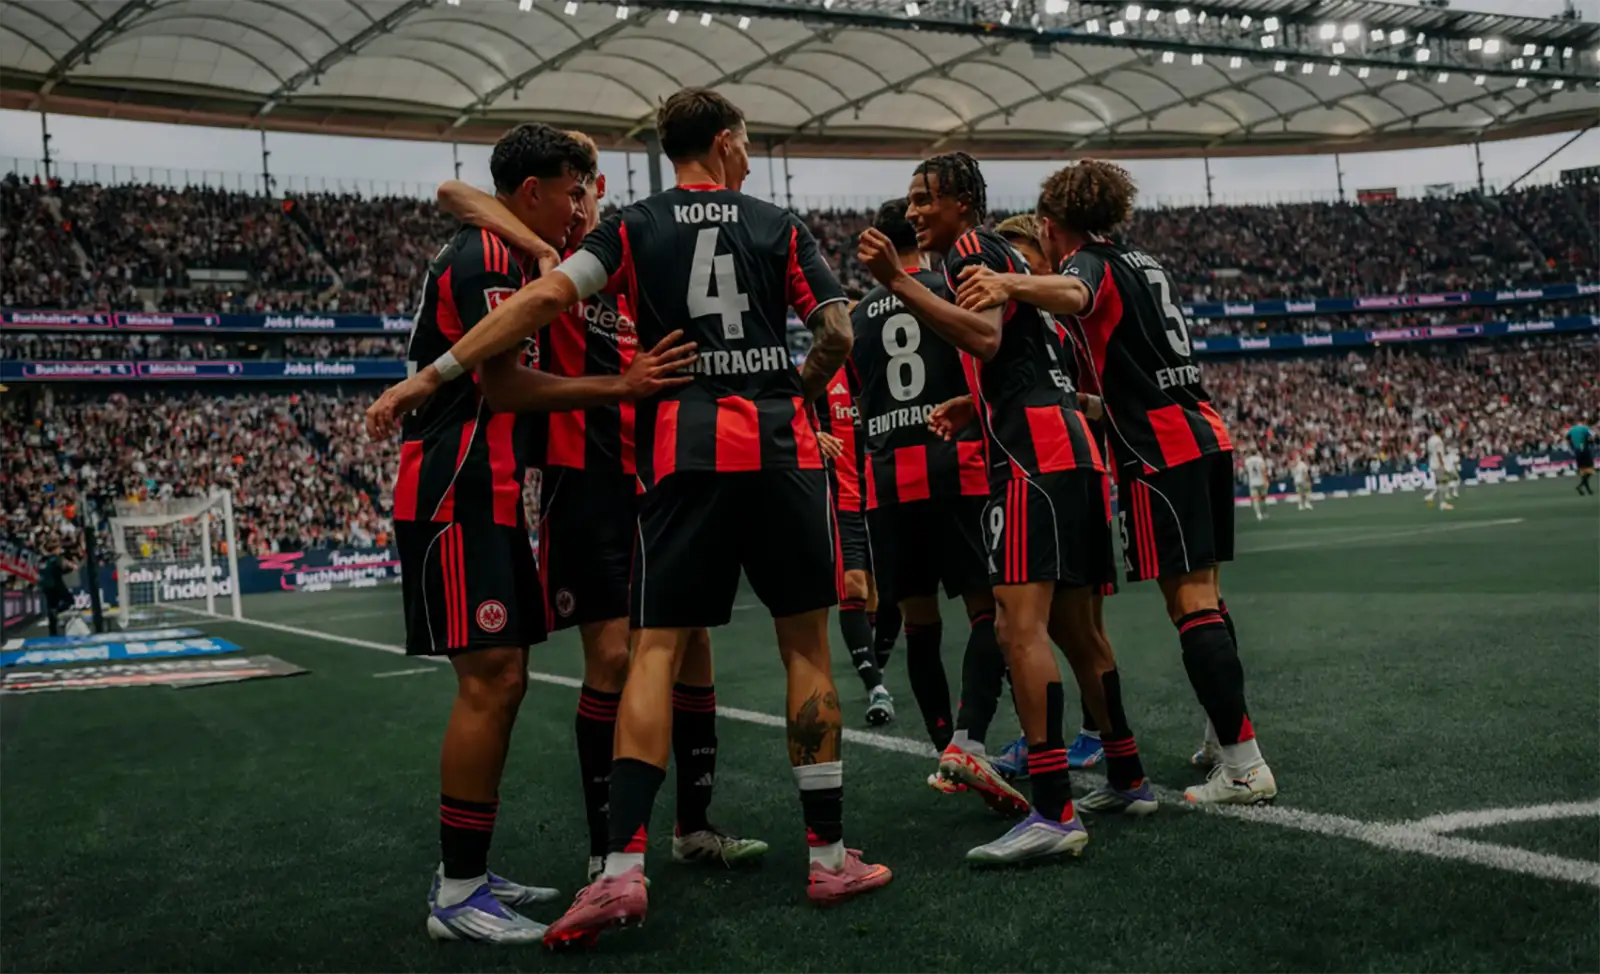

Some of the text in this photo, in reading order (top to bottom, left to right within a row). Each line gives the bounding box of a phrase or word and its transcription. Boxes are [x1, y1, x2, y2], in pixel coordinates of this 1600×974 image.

[673, 202, 739, 224] KOCH
[686, 227, 750, 340] 4
[264, 315, 335, 328] Jobs finden
[569, 301, 636, 332] ndee
[867, 294, 905, 318] CHA
[1144, 270, 1190, 357] 3
[283, 362, 355, 375] Jobs finden
[882, 313, 926, 401] 8
[868, 404, 942, 437] EINTRAC
[990, 506, 1004, 550] 9
[163, 564, 222, 580] findn
